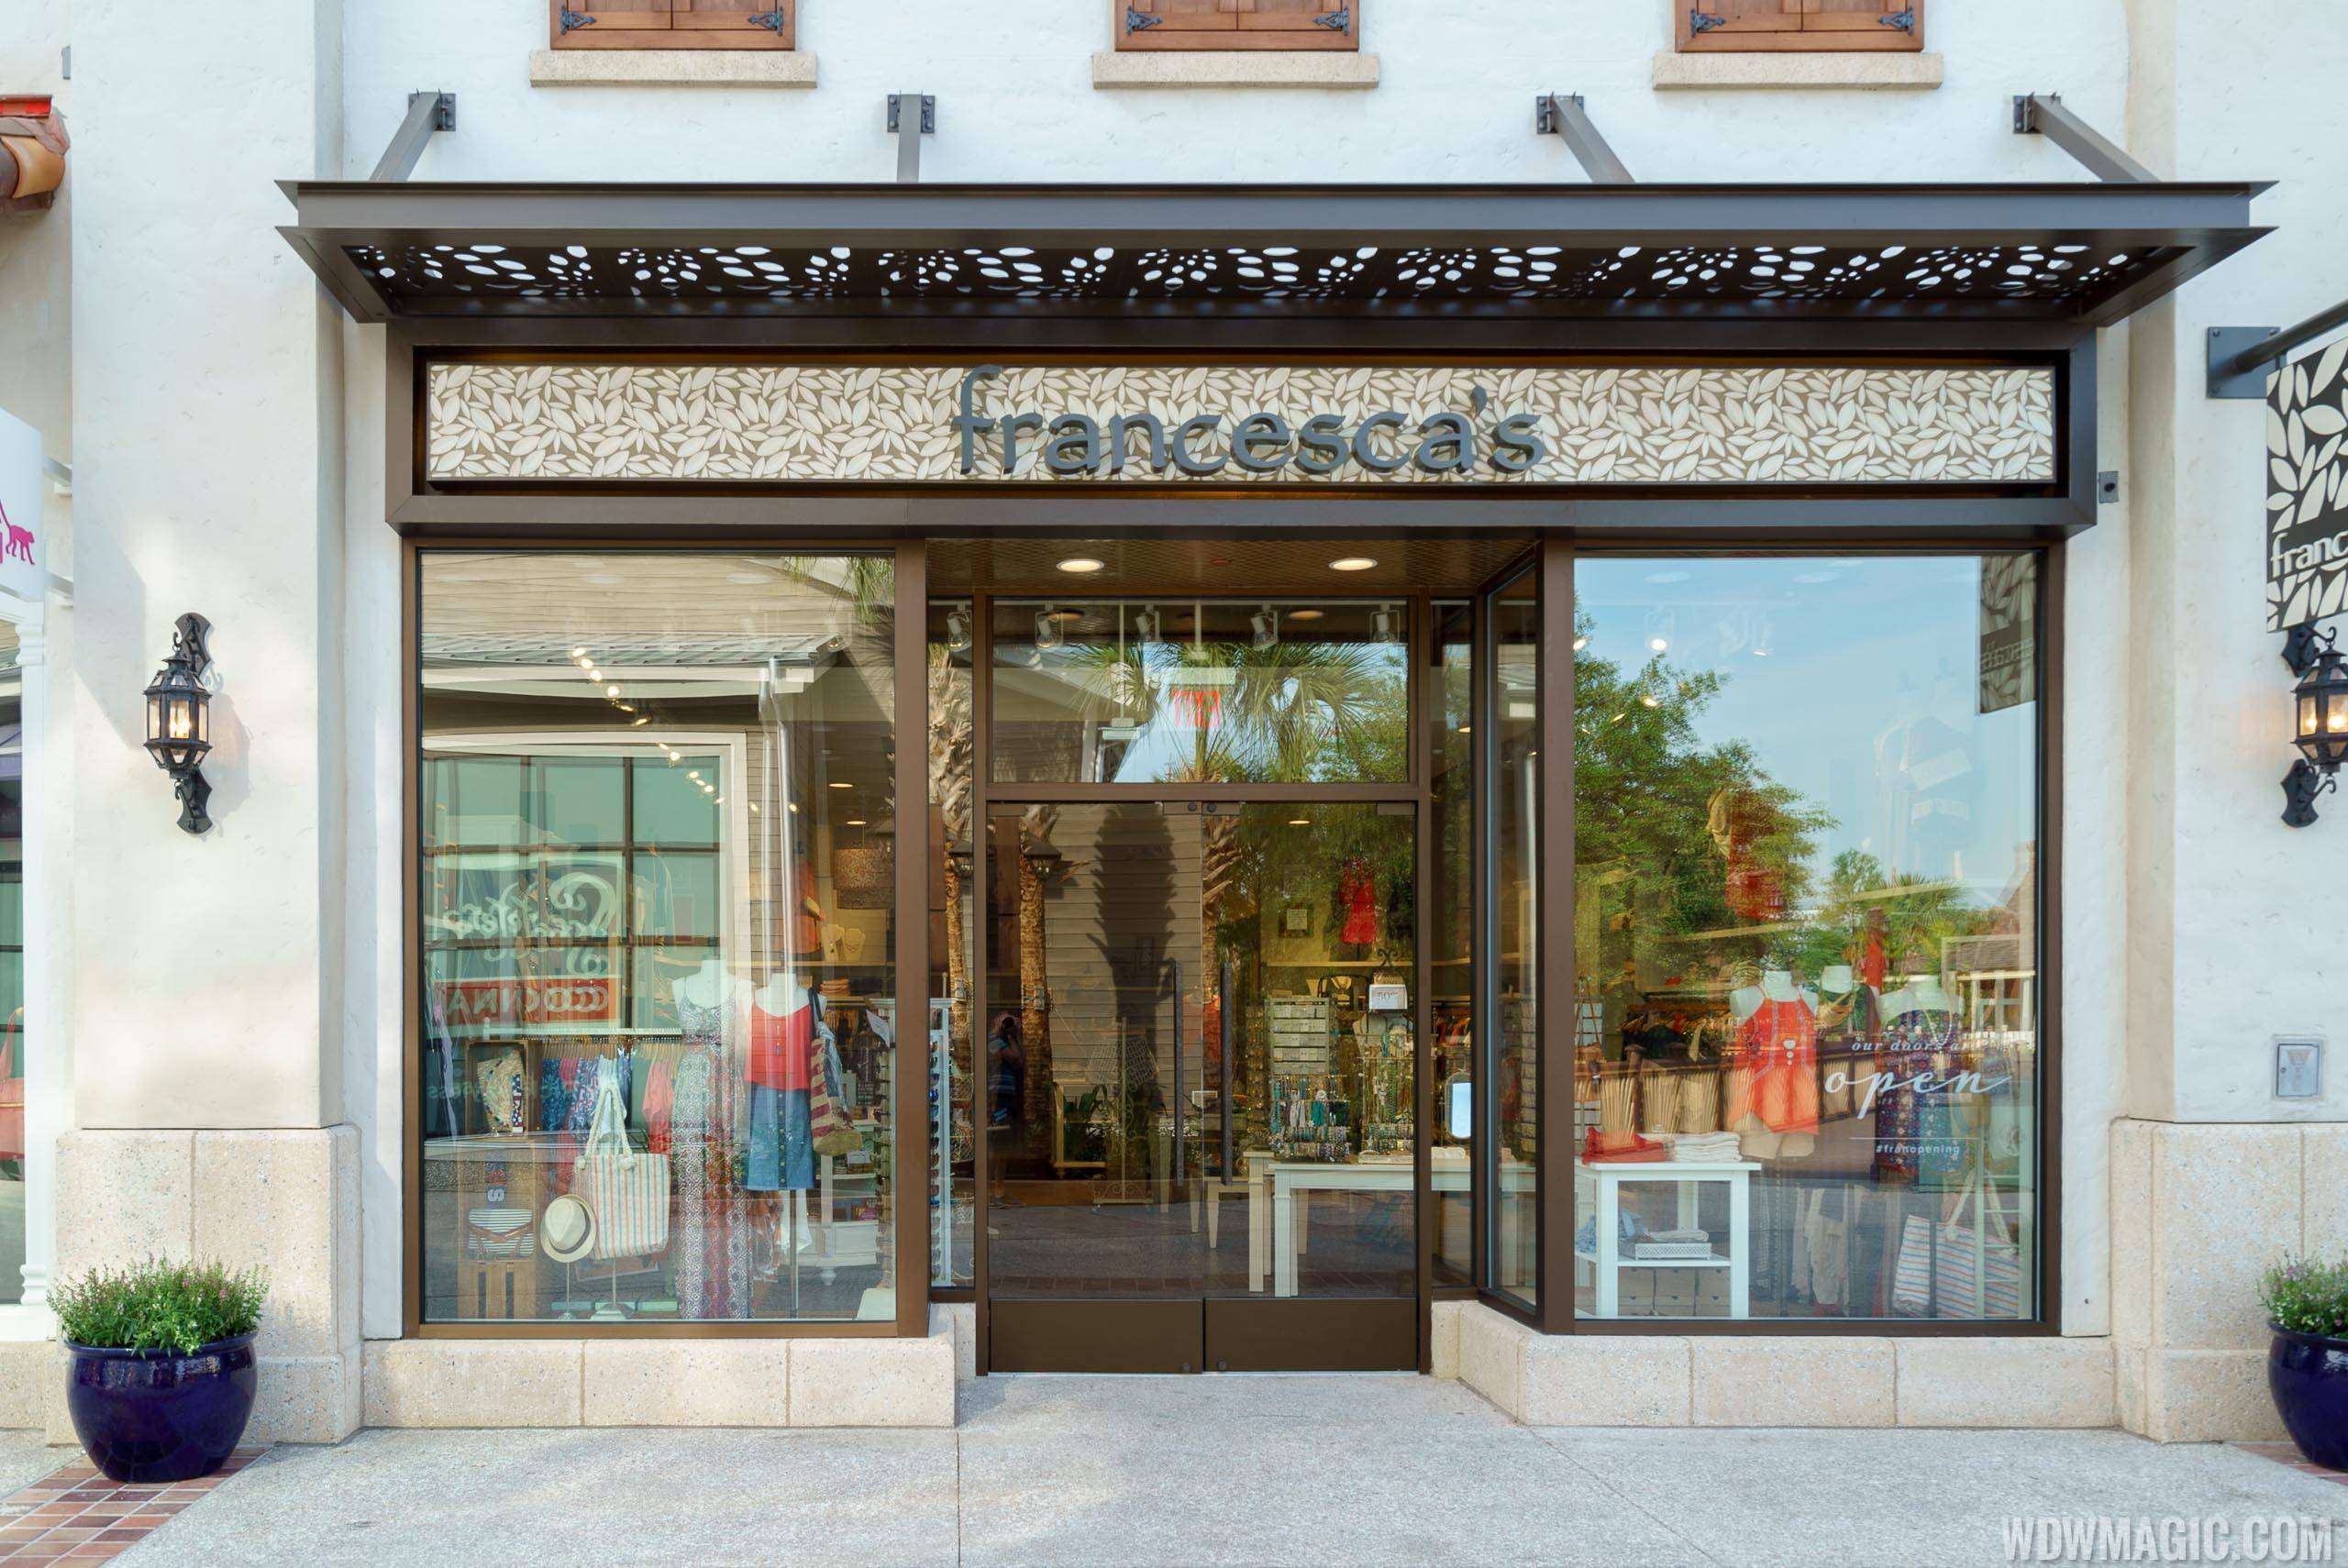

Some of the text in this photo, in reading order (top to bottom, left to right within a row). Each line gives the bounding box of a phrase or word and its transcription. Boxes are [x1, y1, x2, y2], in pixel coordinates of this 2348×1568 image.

[951, 364, 1545, 475] francesca's
[1852, 1042, 1882, 1052] our
[1890, 1039, 1942, 1051] doors
[1824, 1071, 2011, 1120] open
[1876, 1144, 1960, 1154] #franopening
